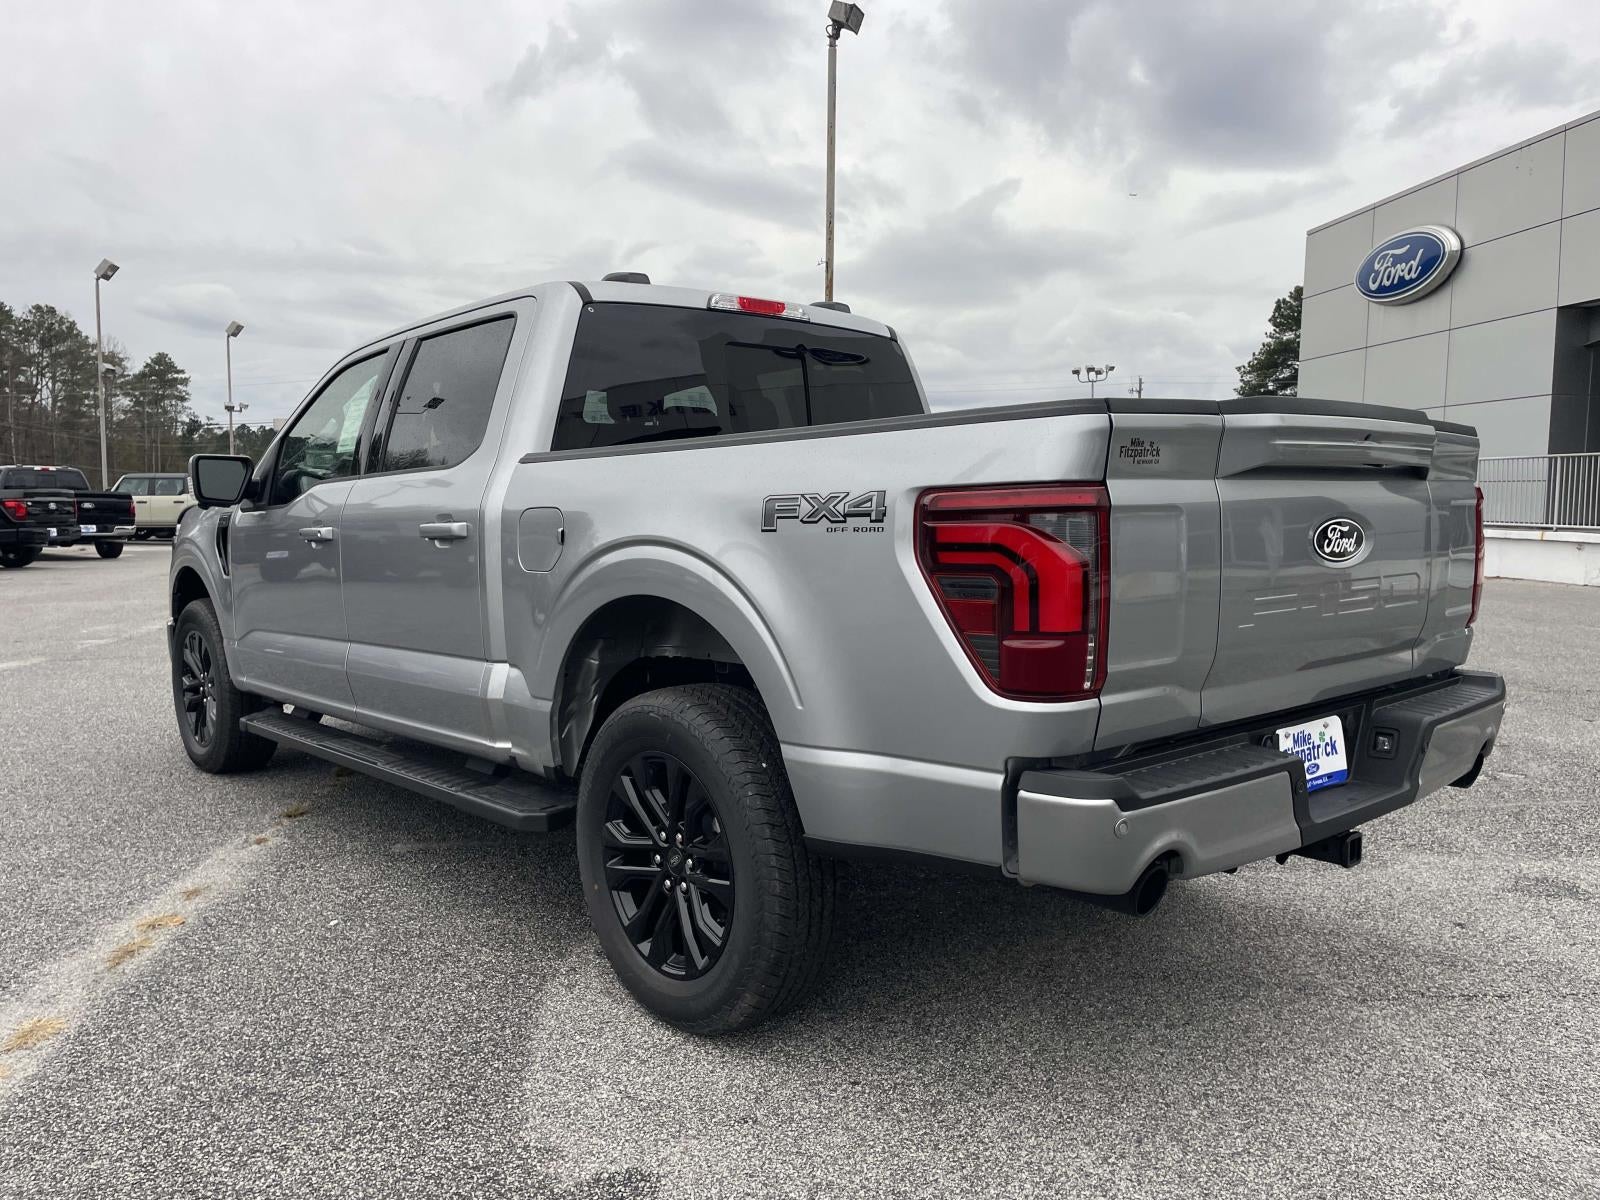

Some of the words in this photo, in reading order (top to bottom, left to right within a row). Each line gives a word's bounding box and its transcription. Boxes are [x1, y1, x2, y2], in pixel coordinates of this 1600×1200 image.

[1368, 244, 1424, 291] Ford
[1119, 445, 1160, 464] Fitzpatrick
[1130, 438, 1145, 448] Mike
[760, 490, 887, 532] FX4
[1323, 524, 1358, 553] Ford
[1282, 735, 1339, 764] patrick
[1292, 729, 1312, 751] Mike
